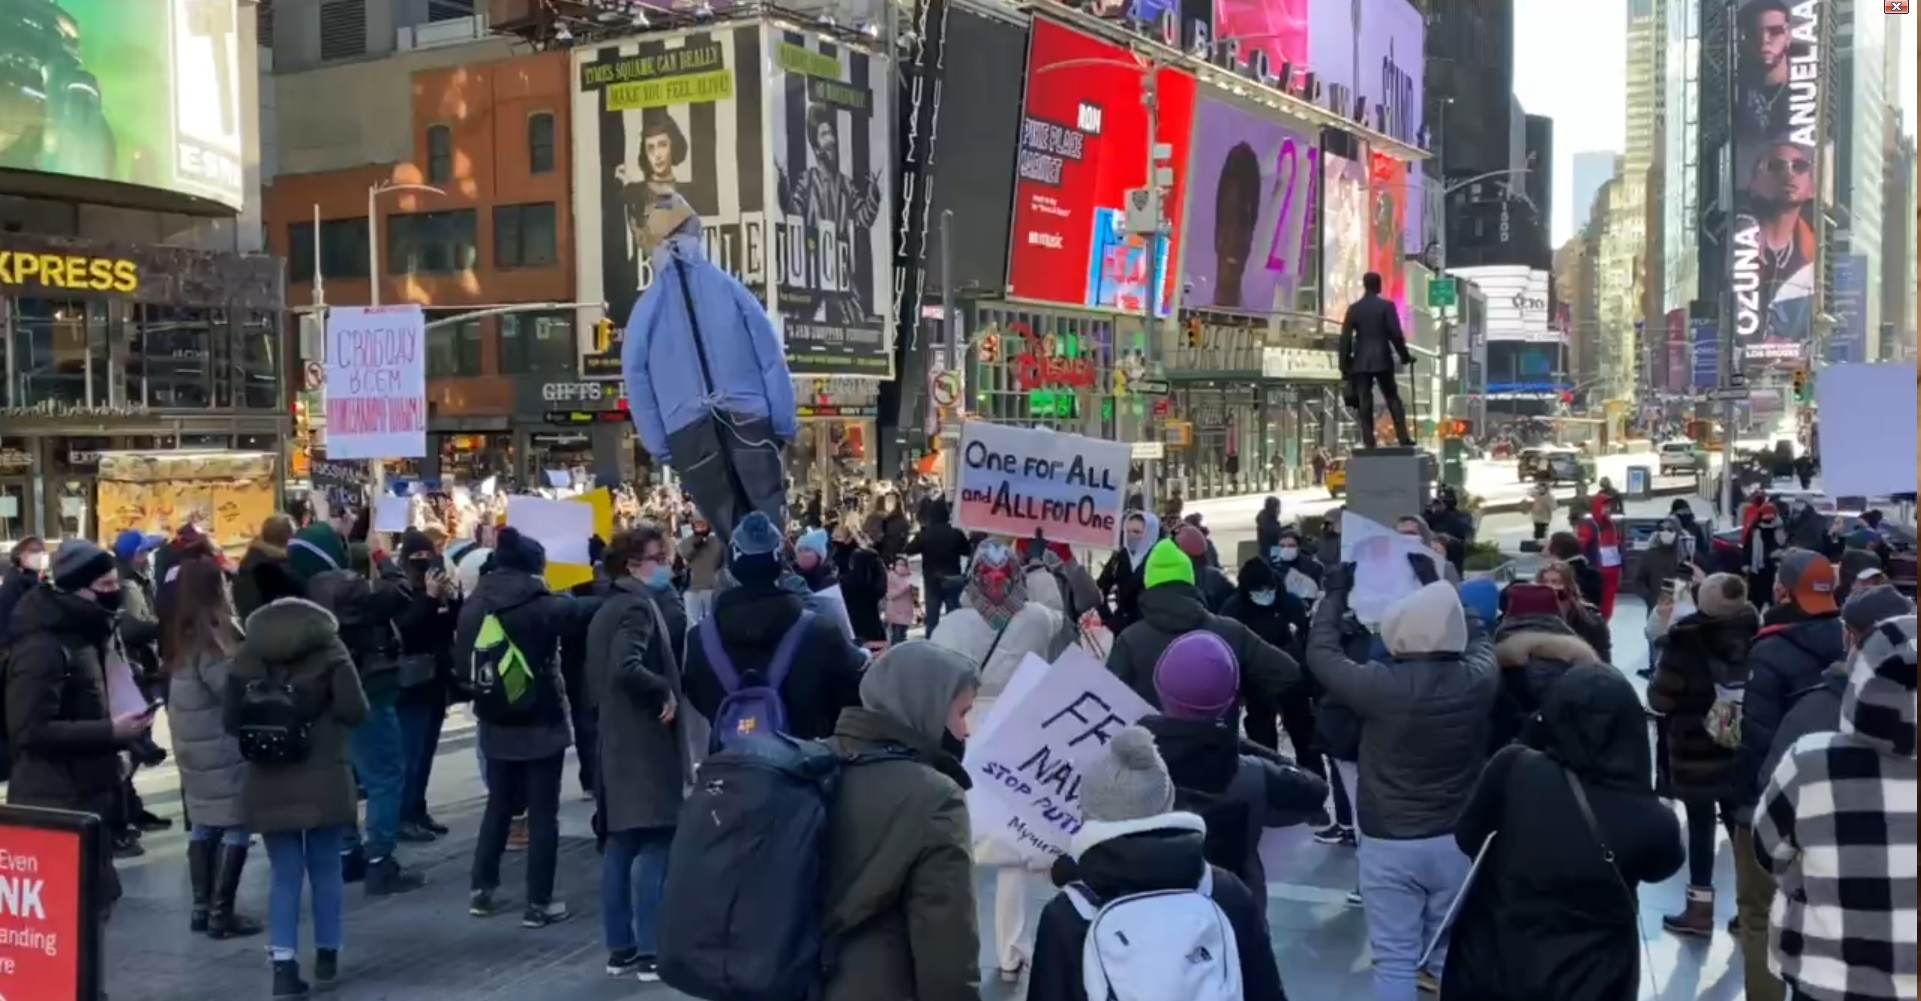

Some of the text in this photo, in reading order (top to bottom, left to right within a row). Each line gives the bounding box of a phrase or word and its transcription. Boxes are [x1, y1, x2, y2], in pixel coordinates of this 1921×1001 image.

[657, 51, 677, 73] CAN
[643, 81, 661, 102] YOU
[667, 78, 694, 100] FEEL
[1733, 224, 1761, 336] OZUNA
[350, 369, 401, 395] ВСЕМ
[542, 381, 602, 402] GIFTS
[964, 440, 1017, 475] One
[961, 484, 992, 506] and
[1077, 494, 1116, 531] One
[981, 760, 1033, 795] STOP
